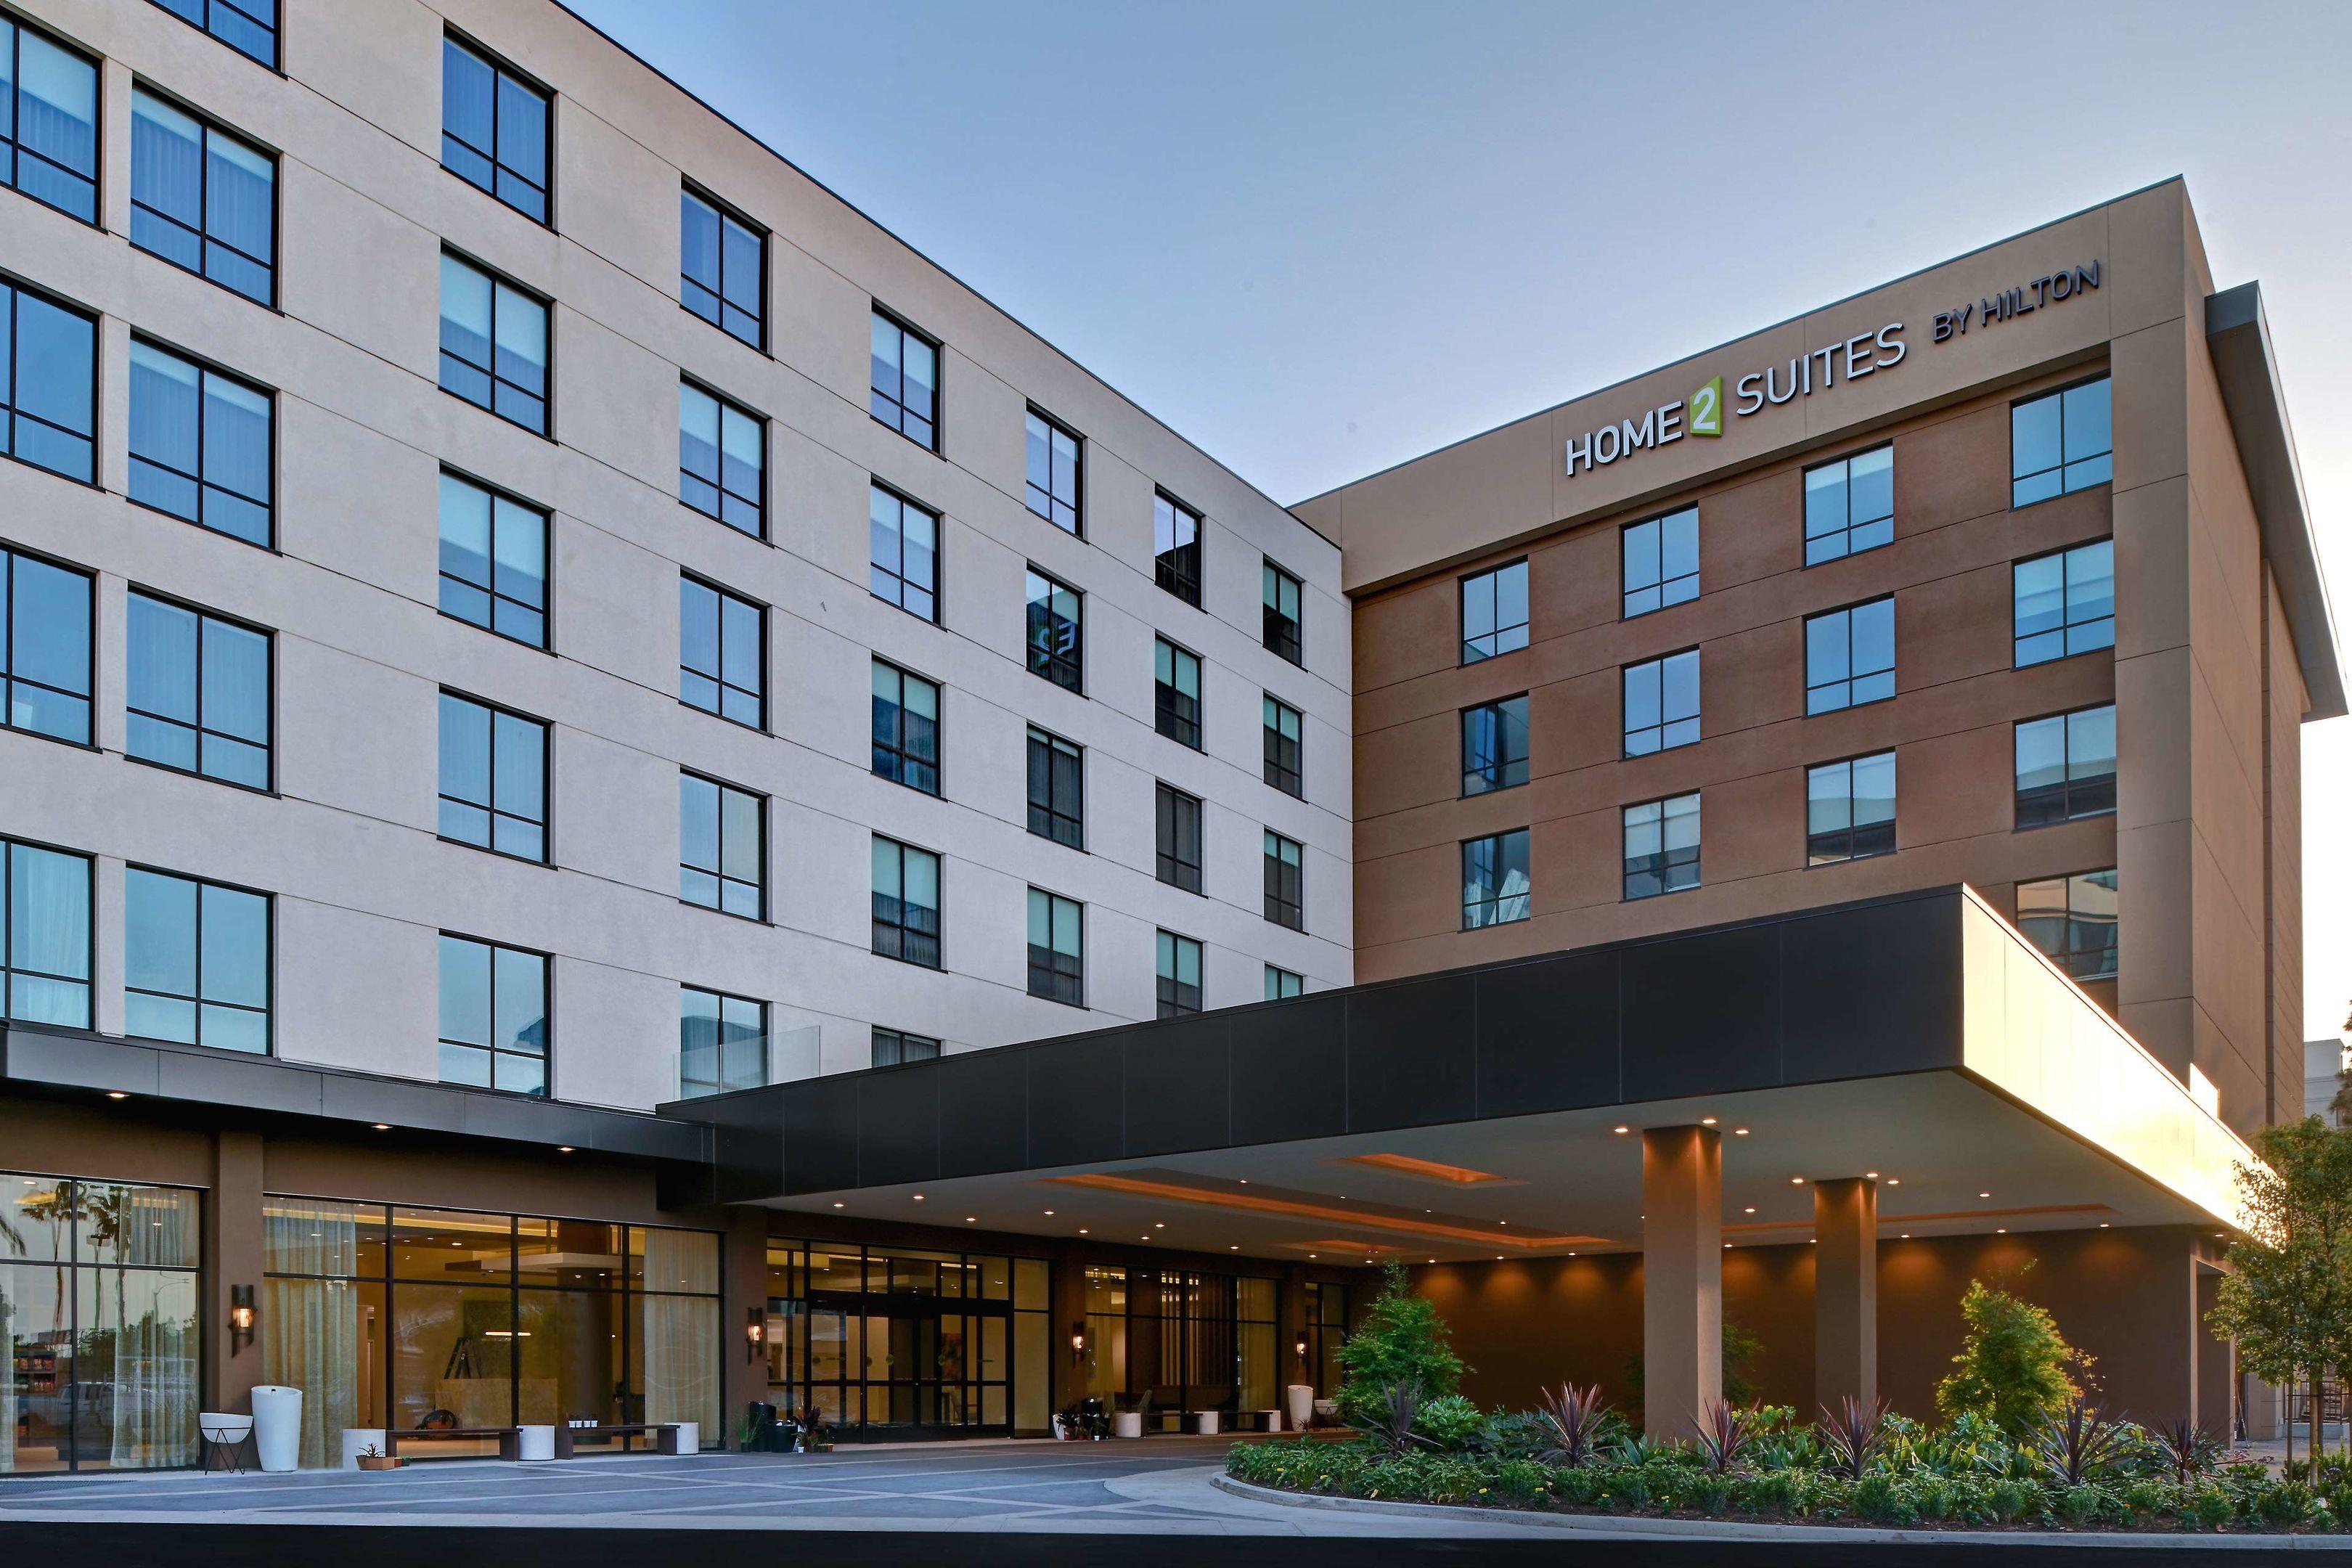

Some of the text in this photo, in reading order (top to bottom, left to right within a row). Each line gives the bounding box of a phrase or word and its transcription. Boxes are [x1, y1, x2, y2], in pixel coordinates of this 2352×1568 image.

[1566, 258, 2099, 477] HOME 2 SUITES BY HILTON
